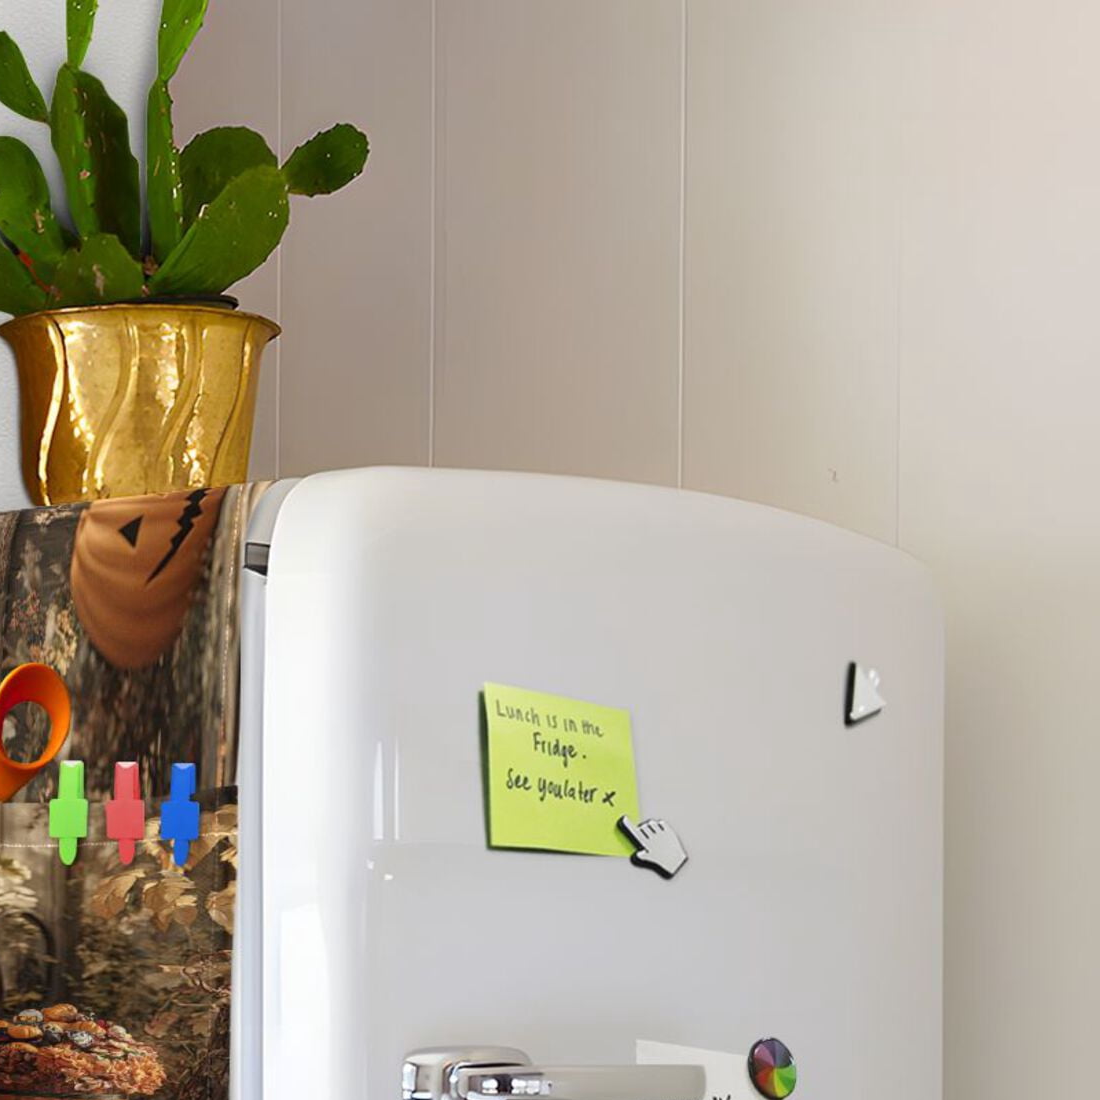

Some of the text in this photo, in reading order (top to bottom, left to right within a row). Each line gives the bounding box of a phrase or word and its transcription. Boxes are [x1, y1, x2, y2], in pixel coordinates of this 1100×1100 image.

[495, 699, 604, 738] Lunch is in the
[506, 768, 532, 791] See
